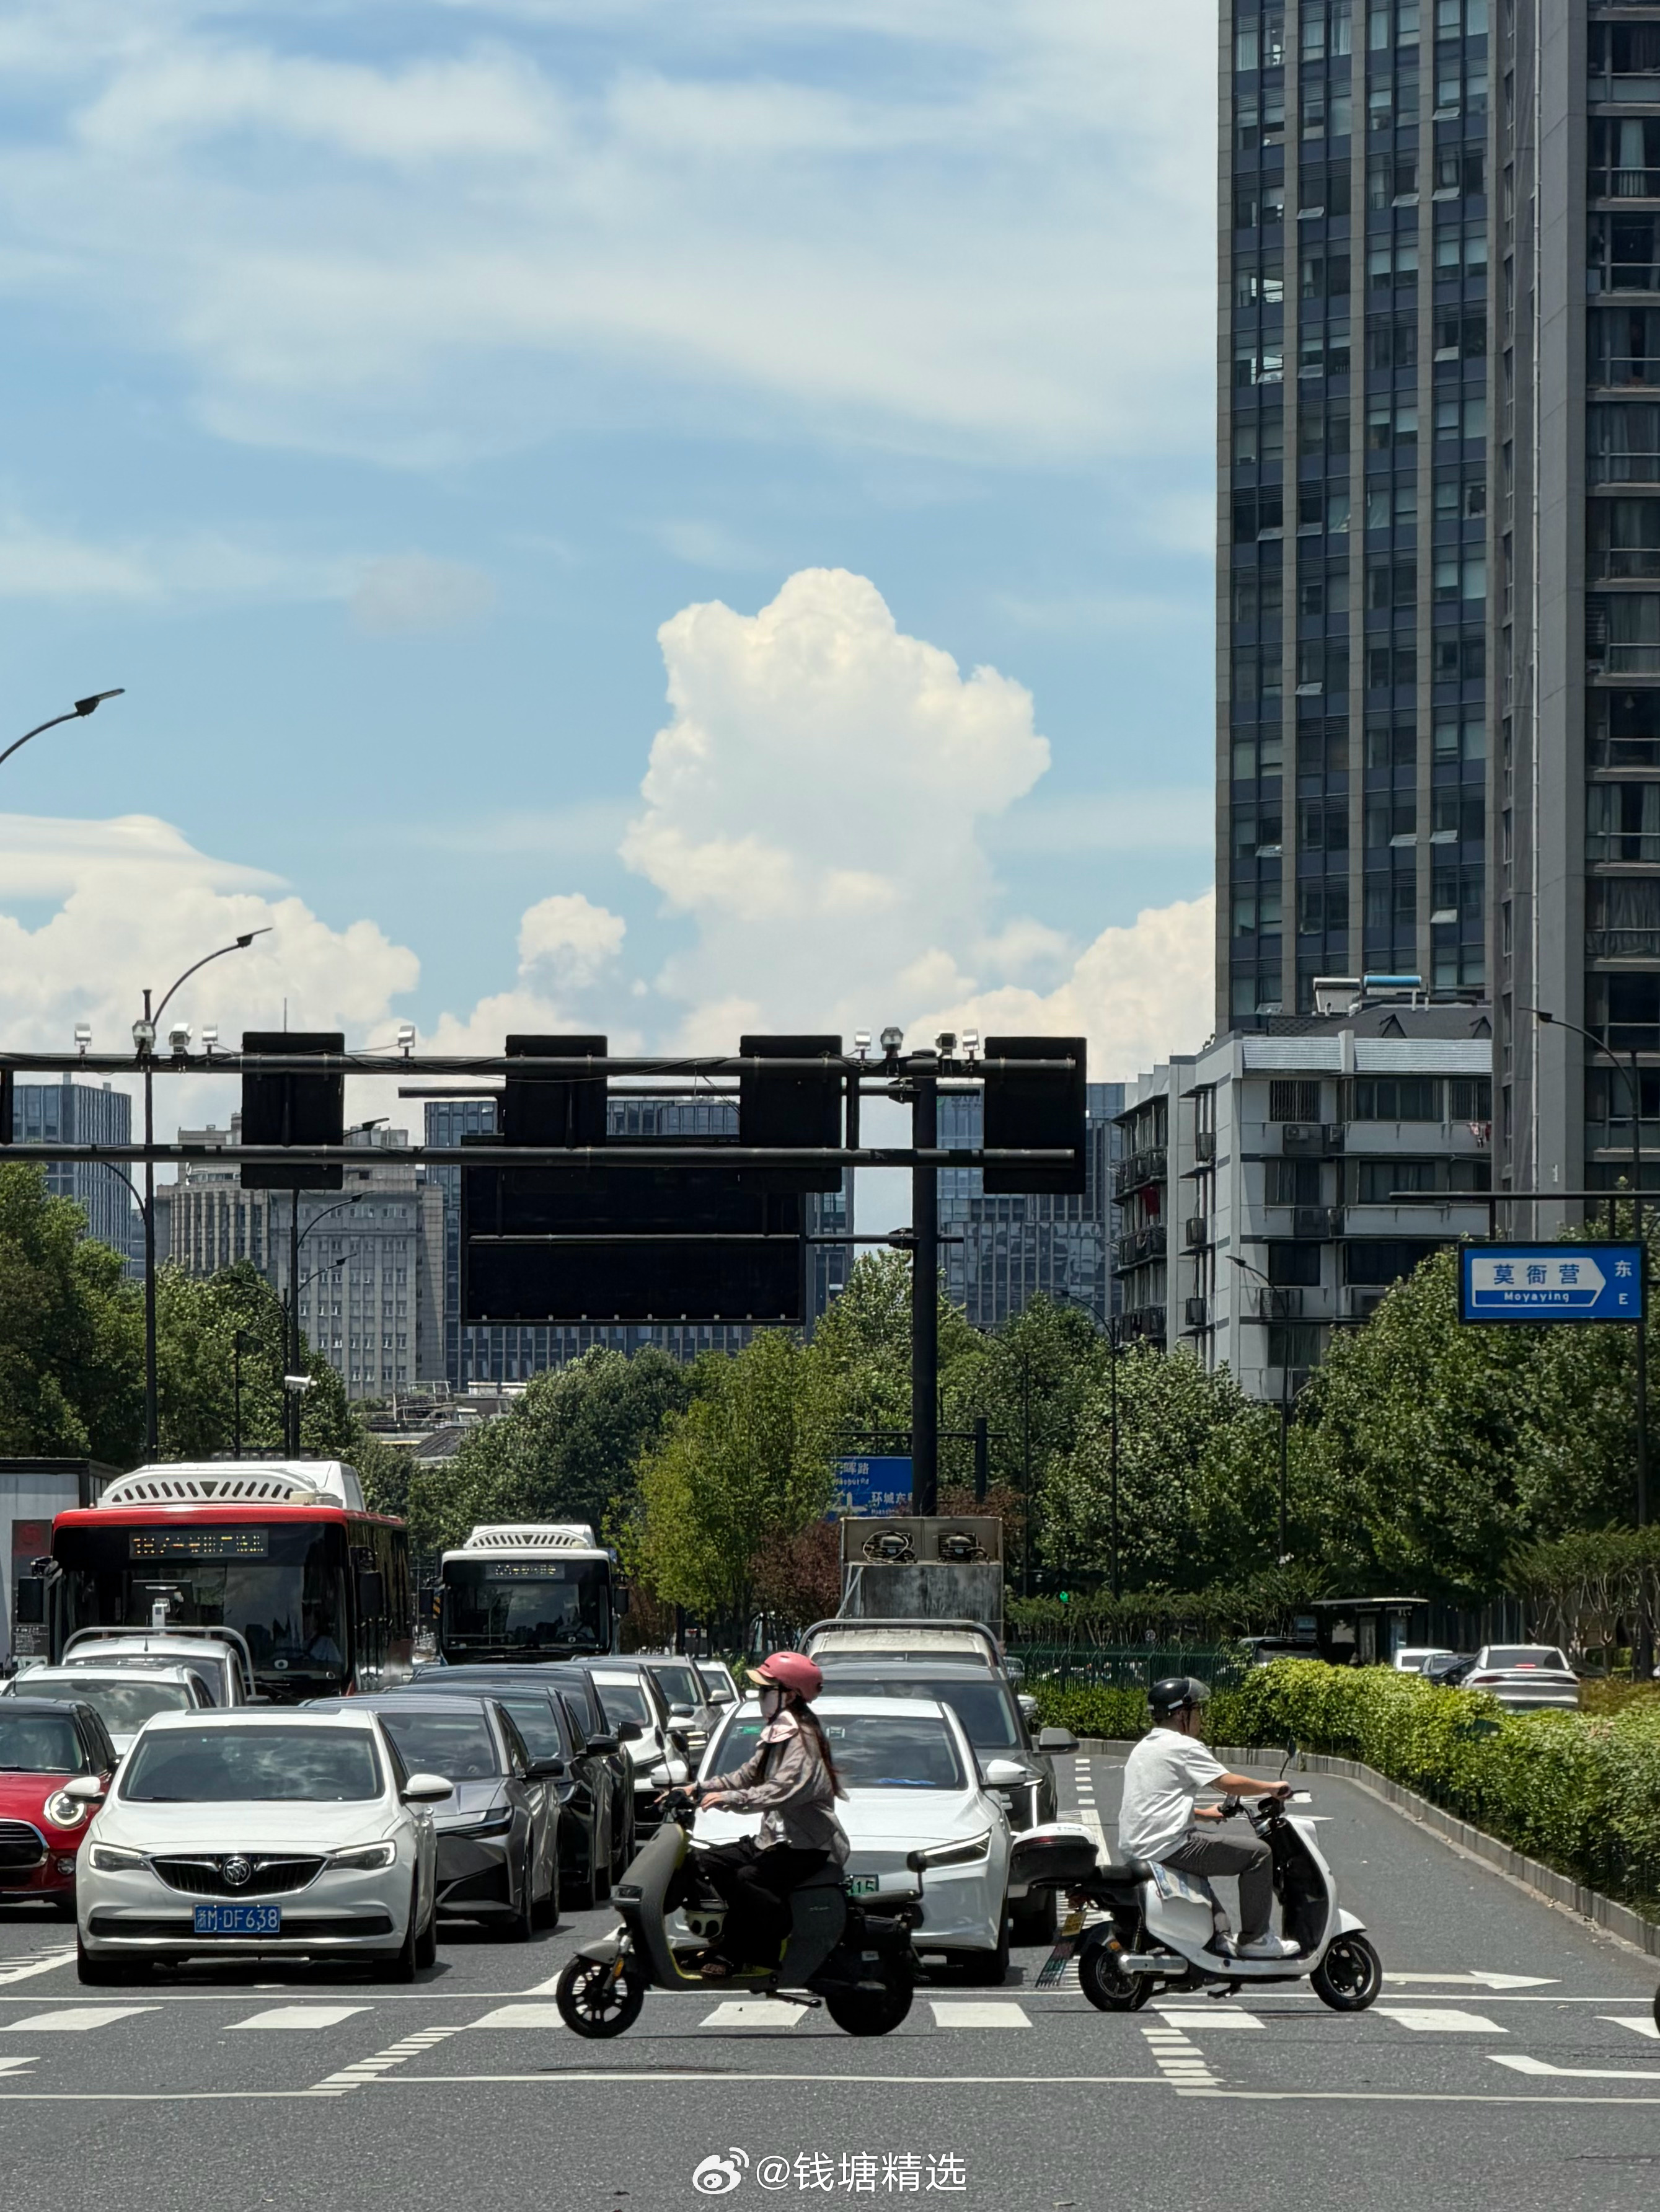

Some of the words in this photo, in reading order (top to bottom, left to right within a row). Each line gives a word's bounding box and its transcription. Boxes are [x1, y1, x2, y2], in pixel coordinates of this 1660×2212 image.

[1493, 1263, 1580, 1285] 莫衙营
[1614, 1260, 1632, 1278] 东
[1504, 1291, 1569, 1303] Moyaying
[1618, 1293, 1628, 1305] E
